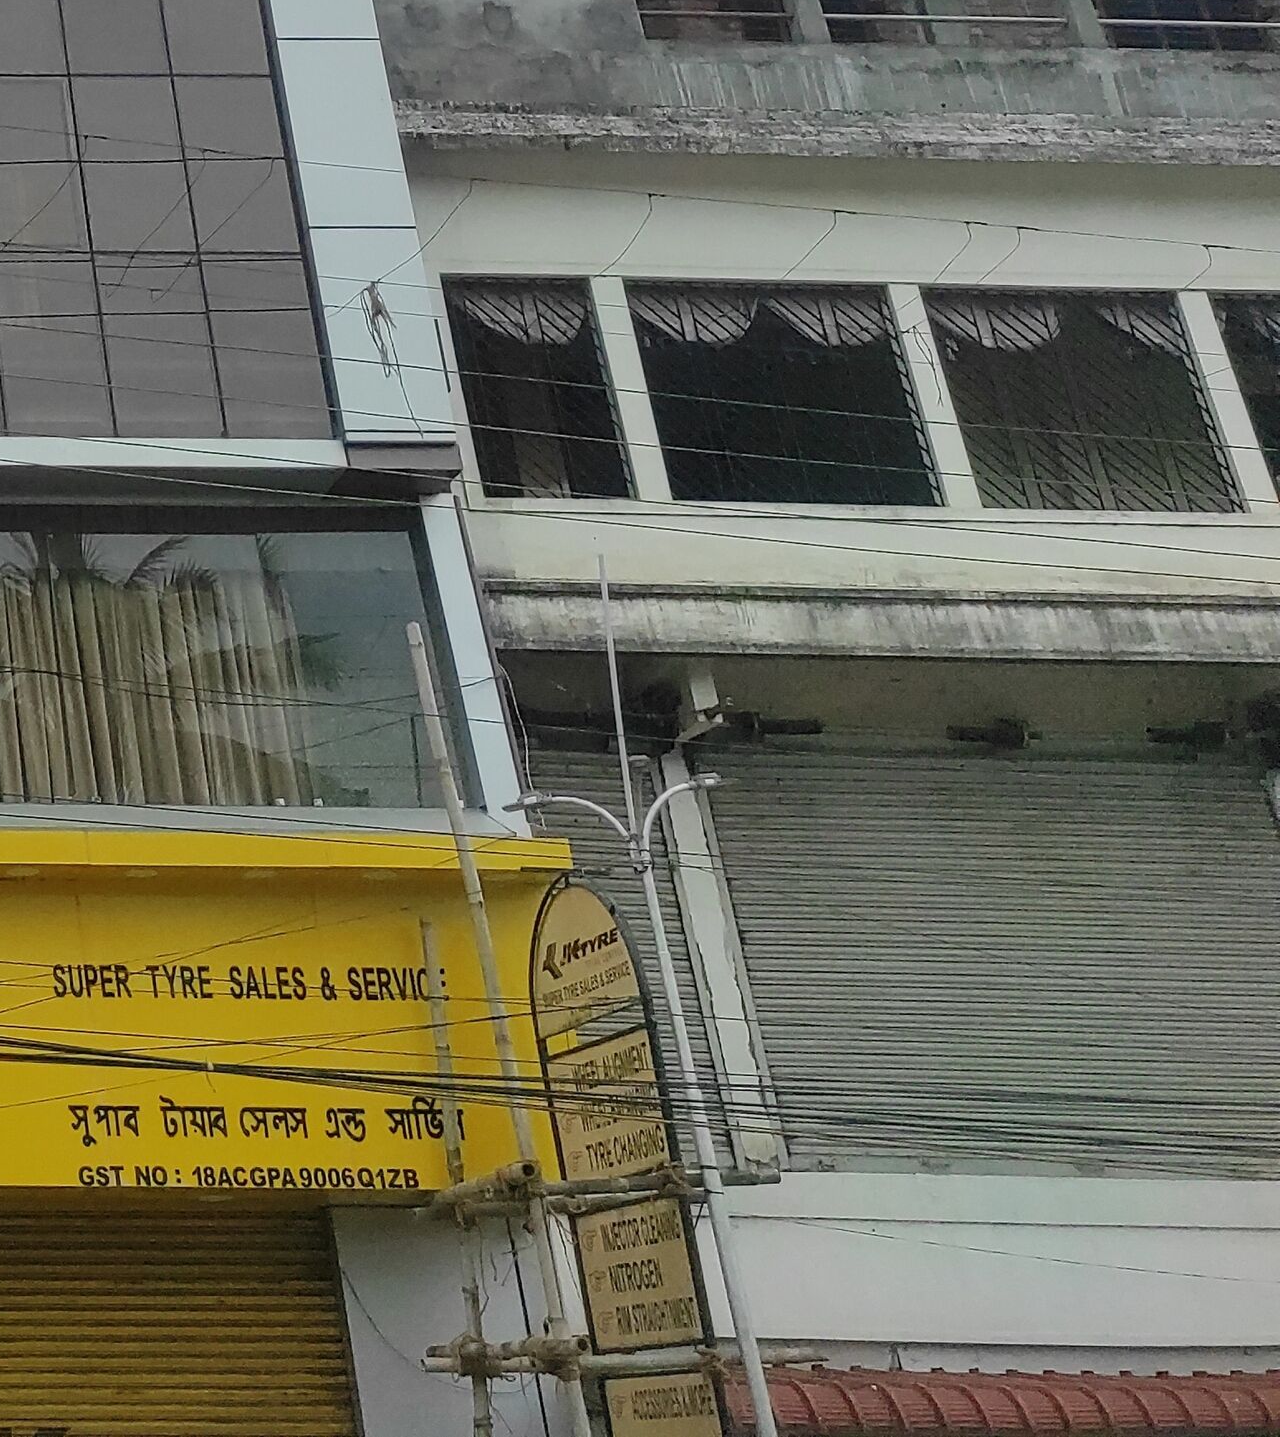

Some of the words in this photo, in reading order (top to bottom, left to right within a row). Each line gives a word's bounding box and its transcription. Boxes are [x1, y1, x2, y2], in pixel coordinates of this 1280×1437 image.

[52, 964, 132, 999] SUPER
[146, 965, 213, 999] TYRE
[229, 966, 308, 1001] SALES
[320, 966, 338, 1001] &
[240, 1107, 308, 1139] সেলস
[586, 1140, 615, 1171] TYRE
[613, 1124, 665, 1165] CHANGING
[78, 1166, 124, 1187] GST
[192, 1166, 420, 1189] 18ACGPA9006Q1ZB
[608, 1257, 664, 1293] NITROGEN
